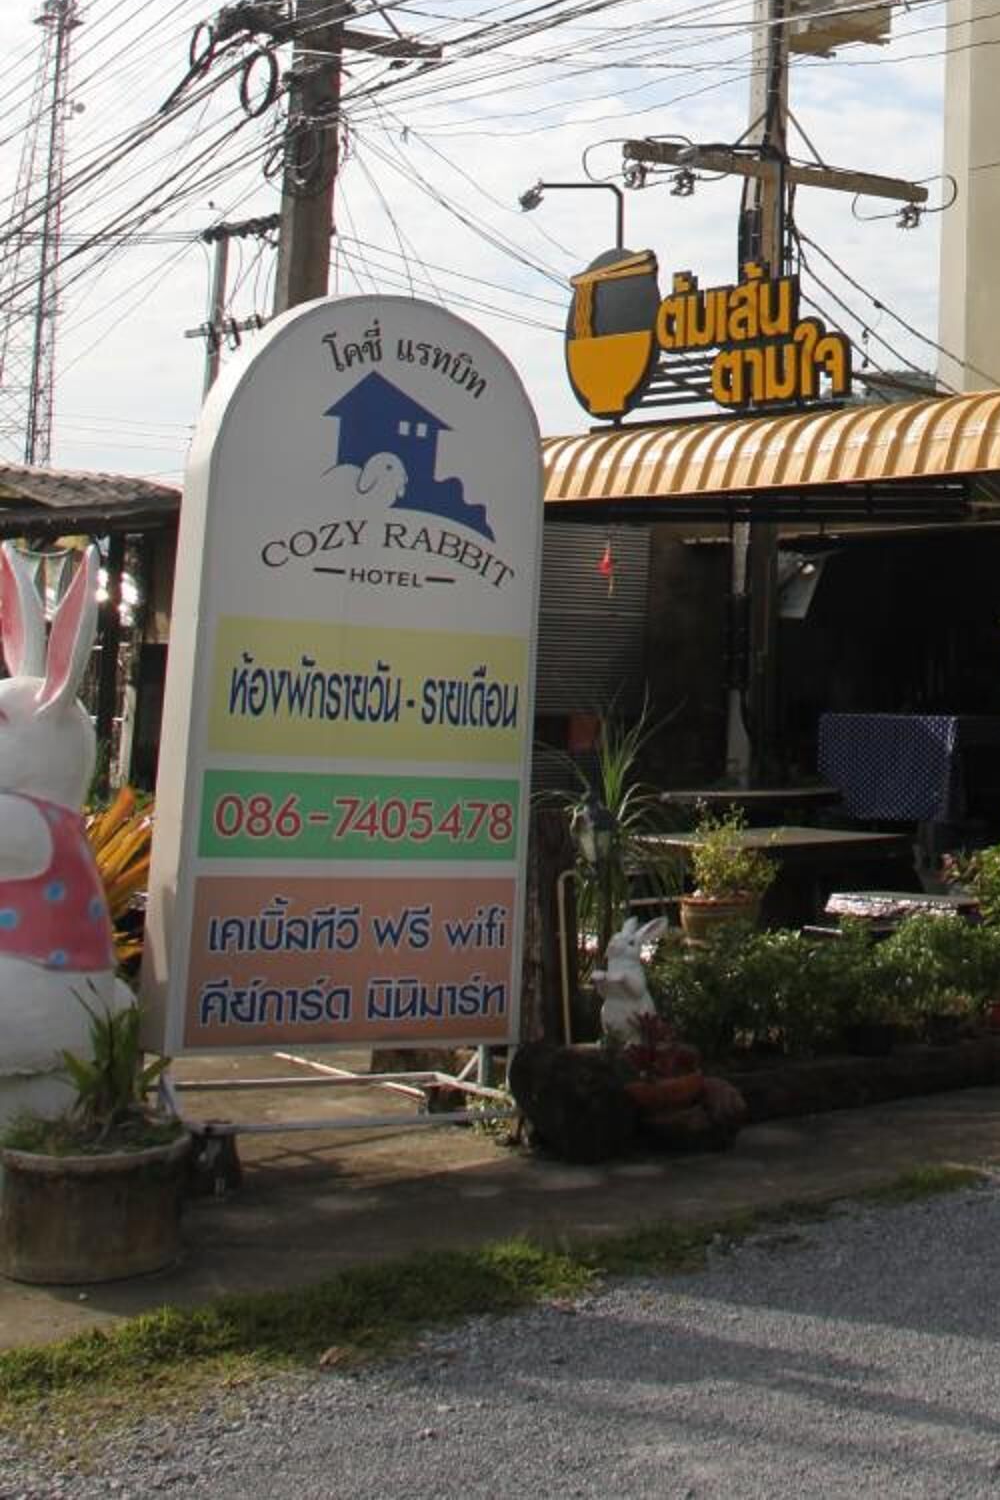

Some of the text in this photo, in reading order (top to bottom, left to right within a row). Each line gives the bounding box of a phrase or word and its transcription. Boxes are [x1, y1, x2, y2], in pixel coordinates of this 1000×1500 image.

[261, 520, 515, 588] COZY RABBIT
[350, 568, 424, 587] HOTEL
[214, 794, 514, 841] 086-7405478
[373, 906, 432, 949] ฟรี
[445, 908, 506, 948] wifi
[200, 975, 506, 1025] คีย์การ์ด มินิมาร์ท
